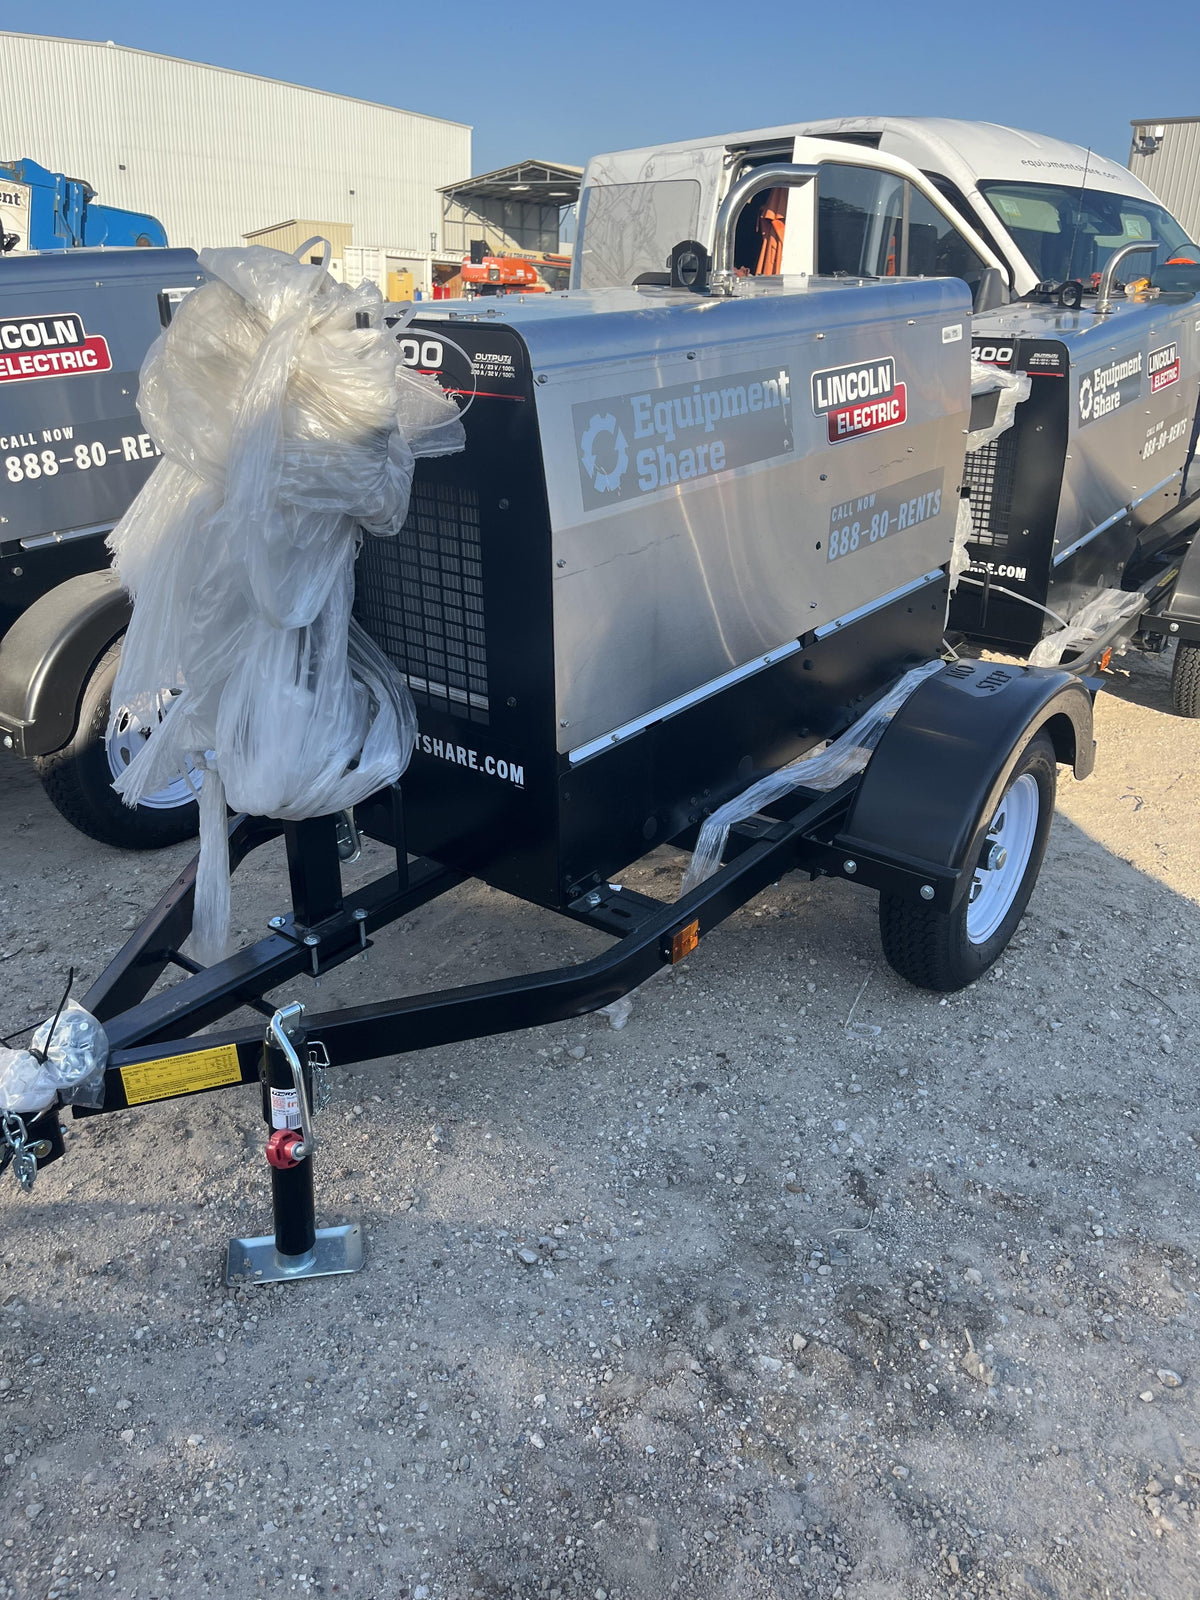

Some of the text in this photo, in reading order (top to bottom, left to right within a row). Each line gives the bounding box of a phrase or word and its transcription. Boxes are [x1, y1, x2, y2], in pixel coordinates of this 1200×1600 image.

[0, 319, 79, 350] COLN
[475, 353, 510, 362] OUTPUT
[1149, 347, 1175, 373] LINCOLN
[816, 365, 891, 409] LINCOLN
[1094, 352, 1142, 393] Equipment
[1154, 366, 1178, 388] ELECTRIC
[631, 370, 790, 441] Equipment
[837, 400, 900, 435] ELECTRIC
[1093, 391, 1120, 419] Share
[0, 427, 74, 450] CALL NOW
[636, 439, 726, 492] Share
[831, 493, 876, 522] CALL NOW
[828, 488, 942, 560] 888-80-RENTS
[946, 664, 976, 680] NO
[976, 670, 1012, 692] STEP
